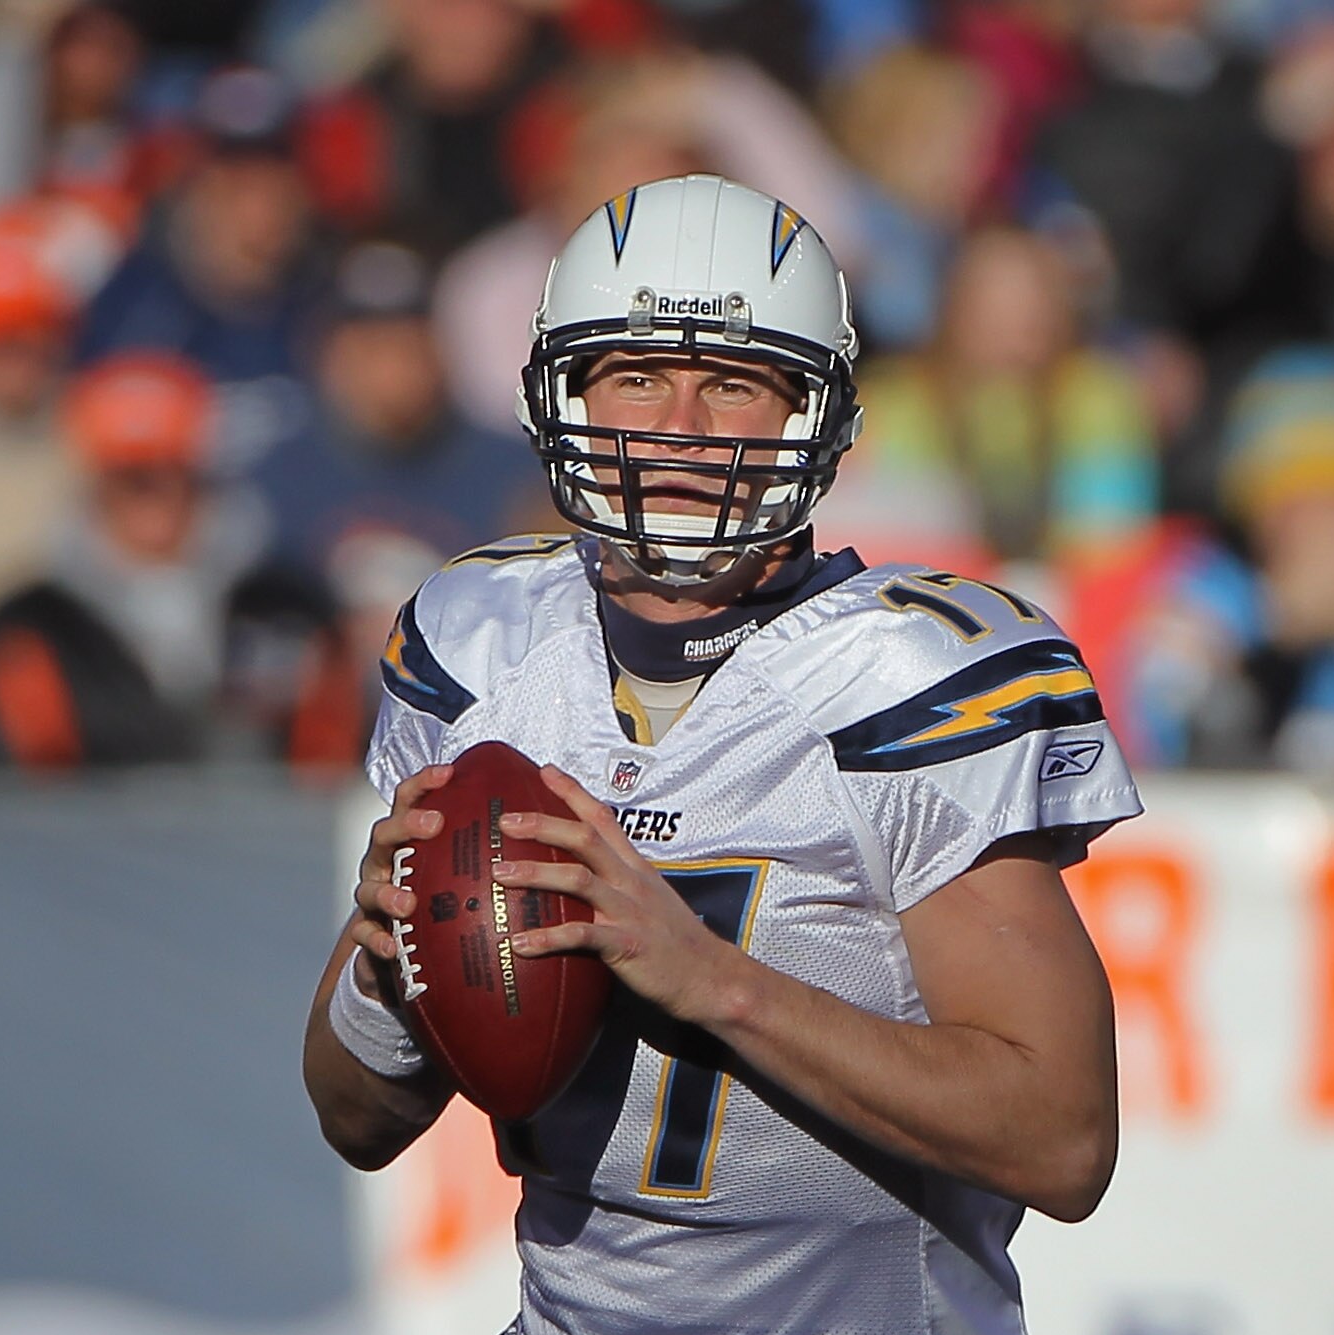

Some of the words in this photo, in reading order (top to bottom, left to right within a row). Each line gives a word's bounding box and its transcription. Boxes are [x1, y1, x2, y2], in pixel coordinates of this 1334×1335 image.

[658, 294, 722, 316] Riddell
[876, 571, 1043, 644] 17
[683, 618, 759, 658] CHARGERS
[610, 806, 683, 841] GERS
[498, 937, 521, 1017] NATIONAL
